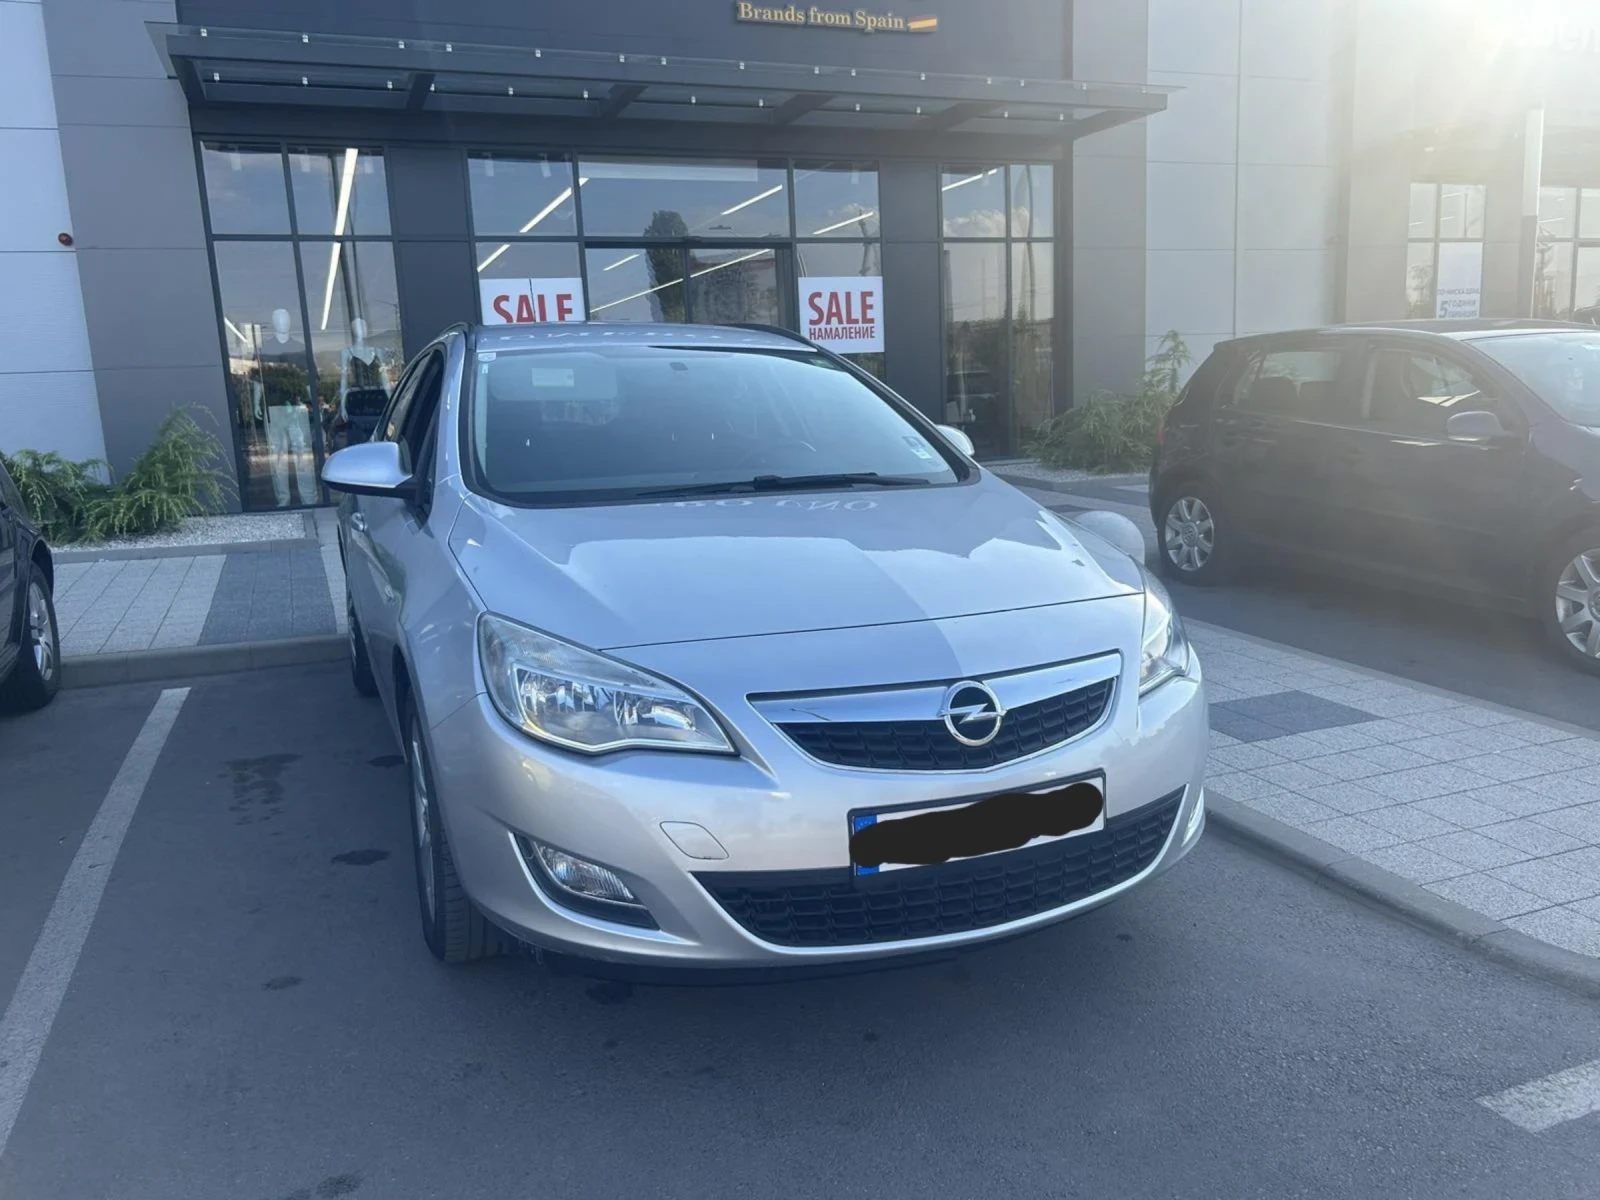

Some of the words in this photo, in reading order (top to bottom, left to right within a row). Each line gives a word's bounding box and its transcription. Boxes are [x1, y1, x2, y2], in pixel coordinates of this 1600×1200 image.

[739, 2, 805, 22] Brands
[808, 7, 850, 26] from
[855, 10, 904, 31] Spain
[493, 293, 573, 323] SALE
[808, 291, 875, 326] SALE
[809, 326, 875, 340] НАМАЛЕНИЕ
